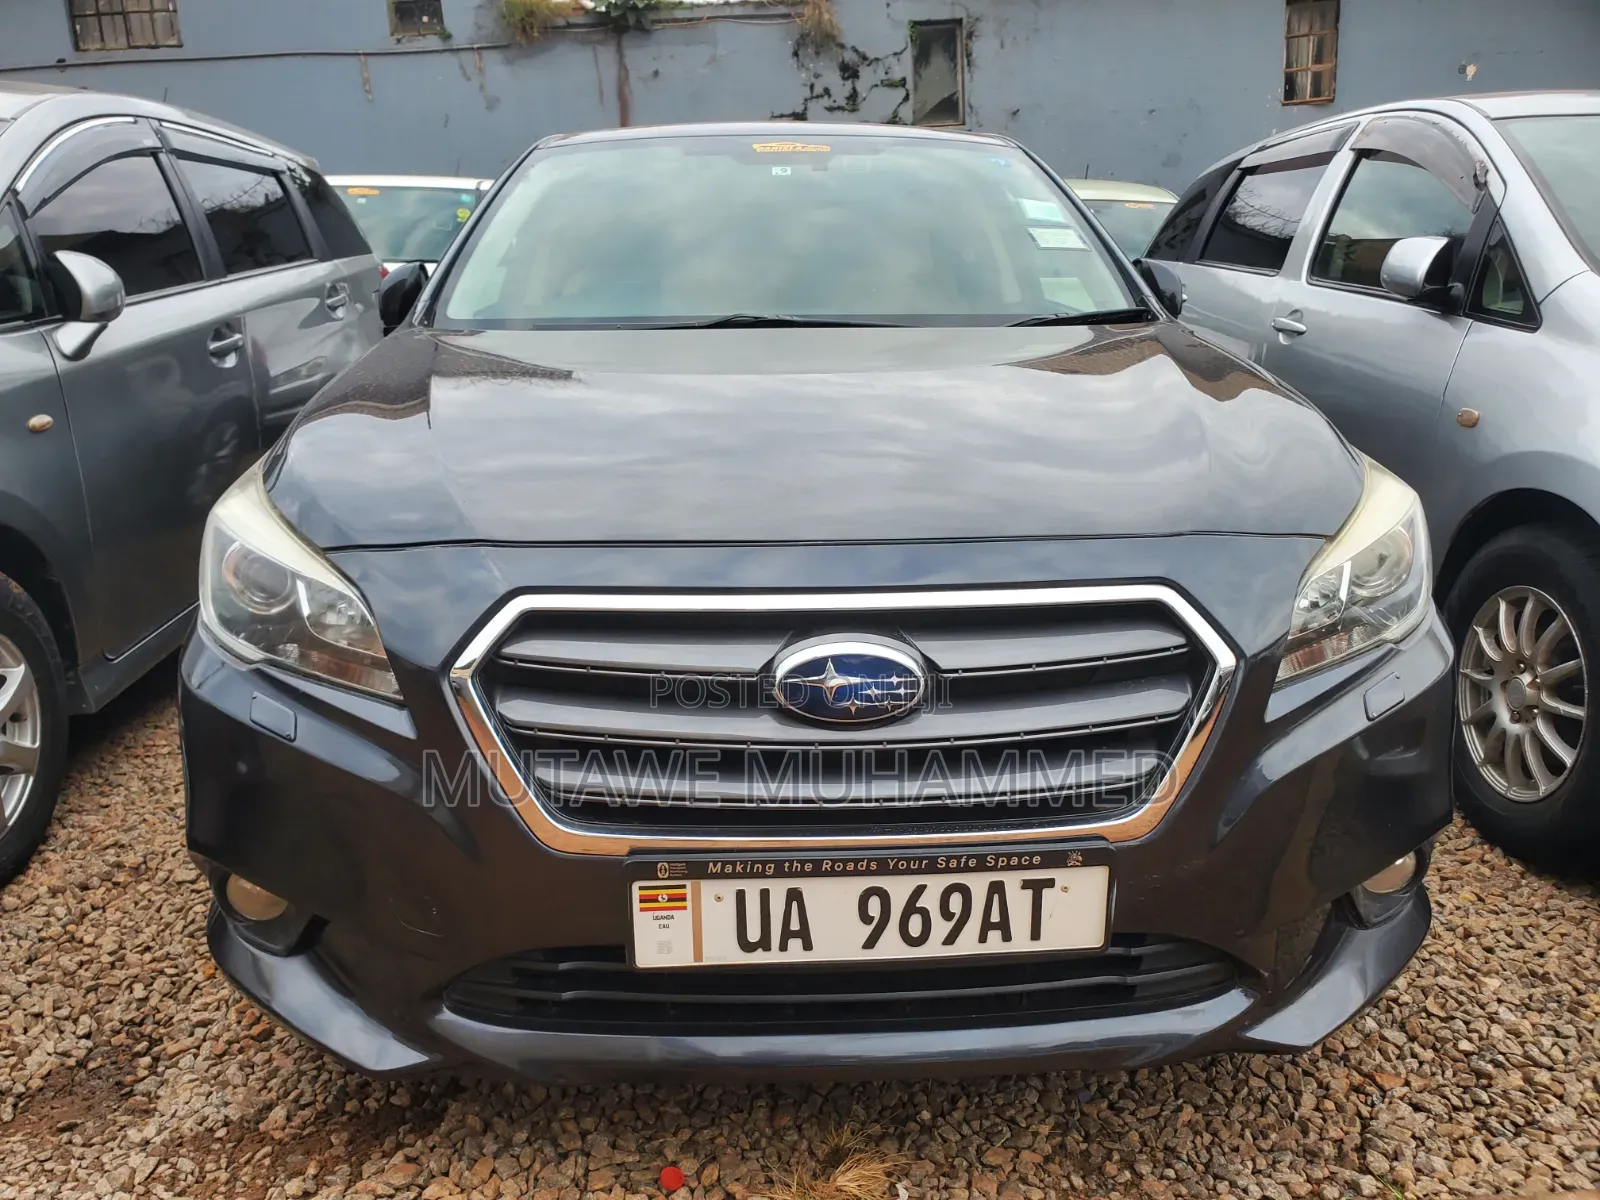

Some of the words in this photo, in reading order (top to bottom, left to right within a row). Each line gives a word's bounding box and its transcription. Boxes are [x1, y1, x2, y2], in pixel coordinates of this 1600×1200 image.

[707, 861, 775, 875] Making
[784, 860, 813, 872] the
[822, 859, 878, 872] Roads
[887, 858, 929, 870] Your
[936, 855, 977, 868] Safe
[985, 854, 1042, 868] Space
[735, 887, 814, 953] UA
[857, 877, 1056, 950] 969AT
